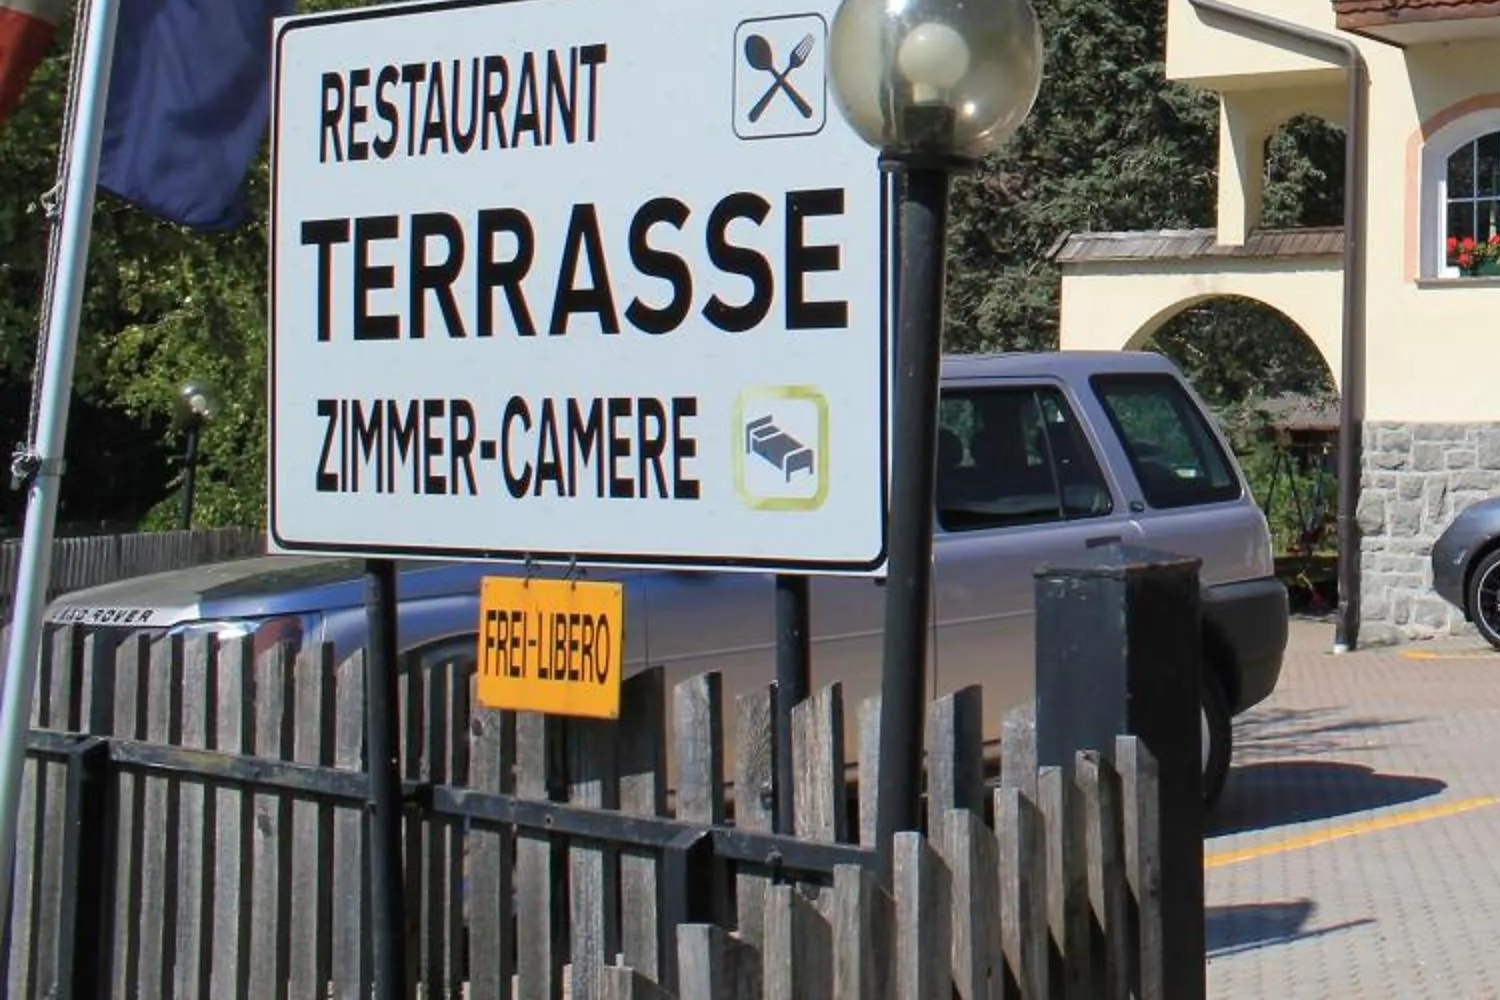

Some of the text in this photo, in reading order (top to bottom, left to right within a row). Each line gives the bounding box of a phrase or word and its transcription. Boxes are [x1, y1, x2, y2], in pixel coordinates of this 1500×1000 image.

[319, 43, 607, 163] RESTAURANT
[301, 187, 849, 341] TERRASSE
[316, 396, 700, 500] ZIMMER-CAMERE
[93, 609, 154, 623] ROVER
[484, 609, 611, 685] FREI-LIBERO
